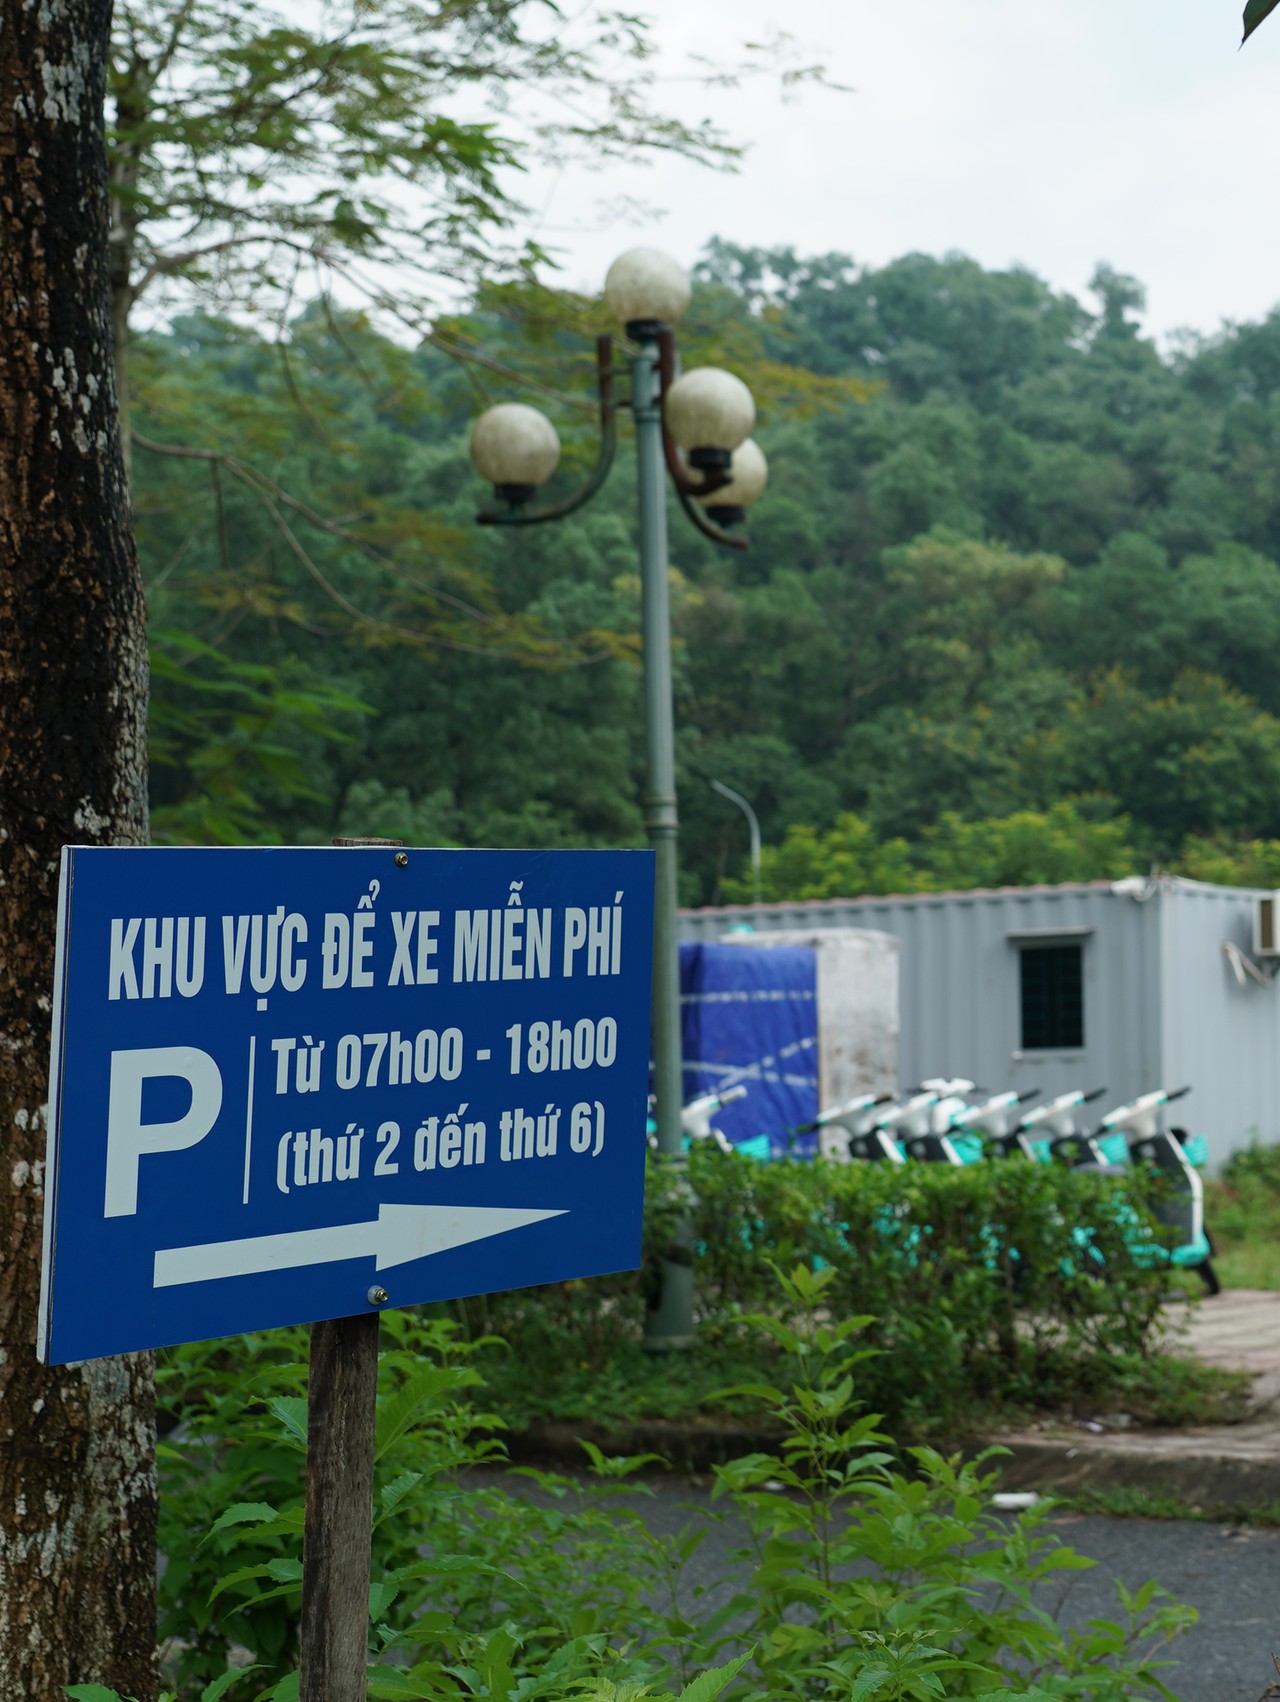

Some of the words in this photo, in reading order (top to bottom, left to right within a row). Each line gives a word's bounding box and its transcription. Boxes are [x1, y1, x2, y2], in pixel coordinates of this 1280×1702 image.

[108, 916, 207, 1001] KHU
[221, 905, 308, 1012] VỰC
[321, 879, 381, 990] ĐỂ
[387, 910, 440, 986] XE
[452, 880, 552, 984] MIỄN
[563, 890, 624, 978] PHÍ
[271, 1035, 325, 1095] Từ
[336, 1027, 464, 1090] 07h00
[476, 1049, 491, 1061] -
[505, 1016, 617, 1075] 18h00
[103, 1045, 223, 1218] P
[276, 1122, 364, 1194] (thứ
[373, 1121, 401, 1176] 2
[413, 1102, 487, 1172] đến
[499, 1103, 562, 1162] thứ
[570, 1100, 605, 1157] 6)
